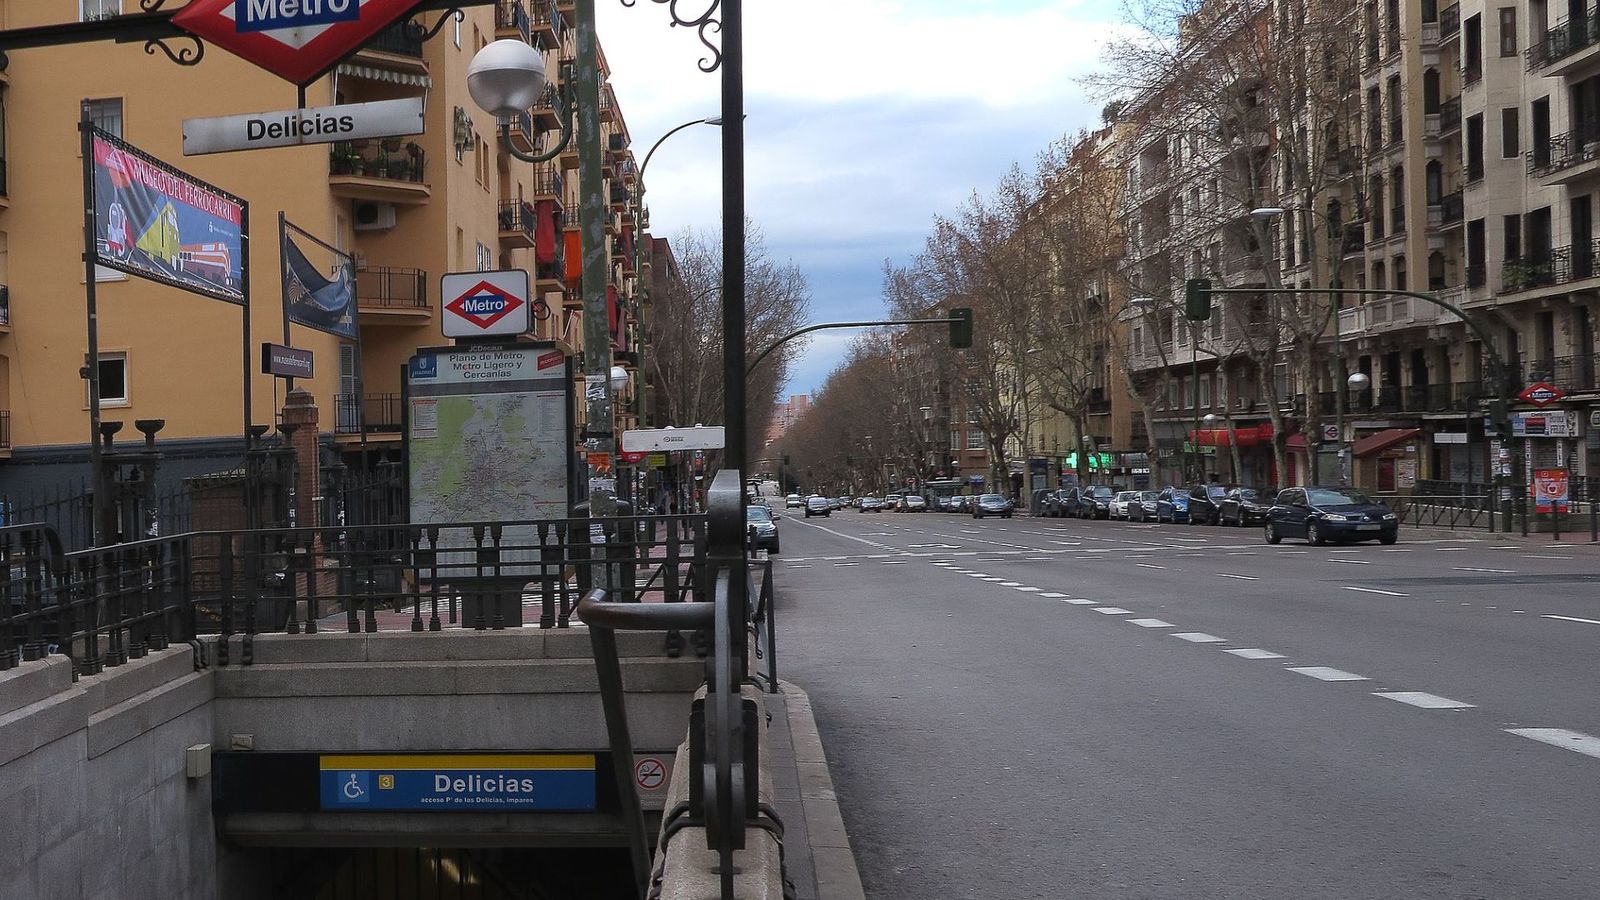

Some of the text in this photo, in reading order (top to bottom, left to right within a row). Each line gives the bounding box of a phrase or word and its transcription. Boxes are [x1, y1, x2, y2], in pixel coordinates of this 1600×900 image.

[246, 0, 350, 23] Metro
[246, 113, 354, 141] Delicias
[132, 160, 234, 222] MUSEO DEL FERROCARRIL
[465, 299, 504, 312] Metro
[449, 352, 526, 362] Plano de Metro,
[453, 361, 522, 371] Metro Ligero y
[463, 369, 512, 379] Cercanías
[382, 776, 391, 788] 3
[434, 774, 534, 793] Delicias
[476, 796, 505, 804] Delicias,
[506, 796, 534, 805] impares
